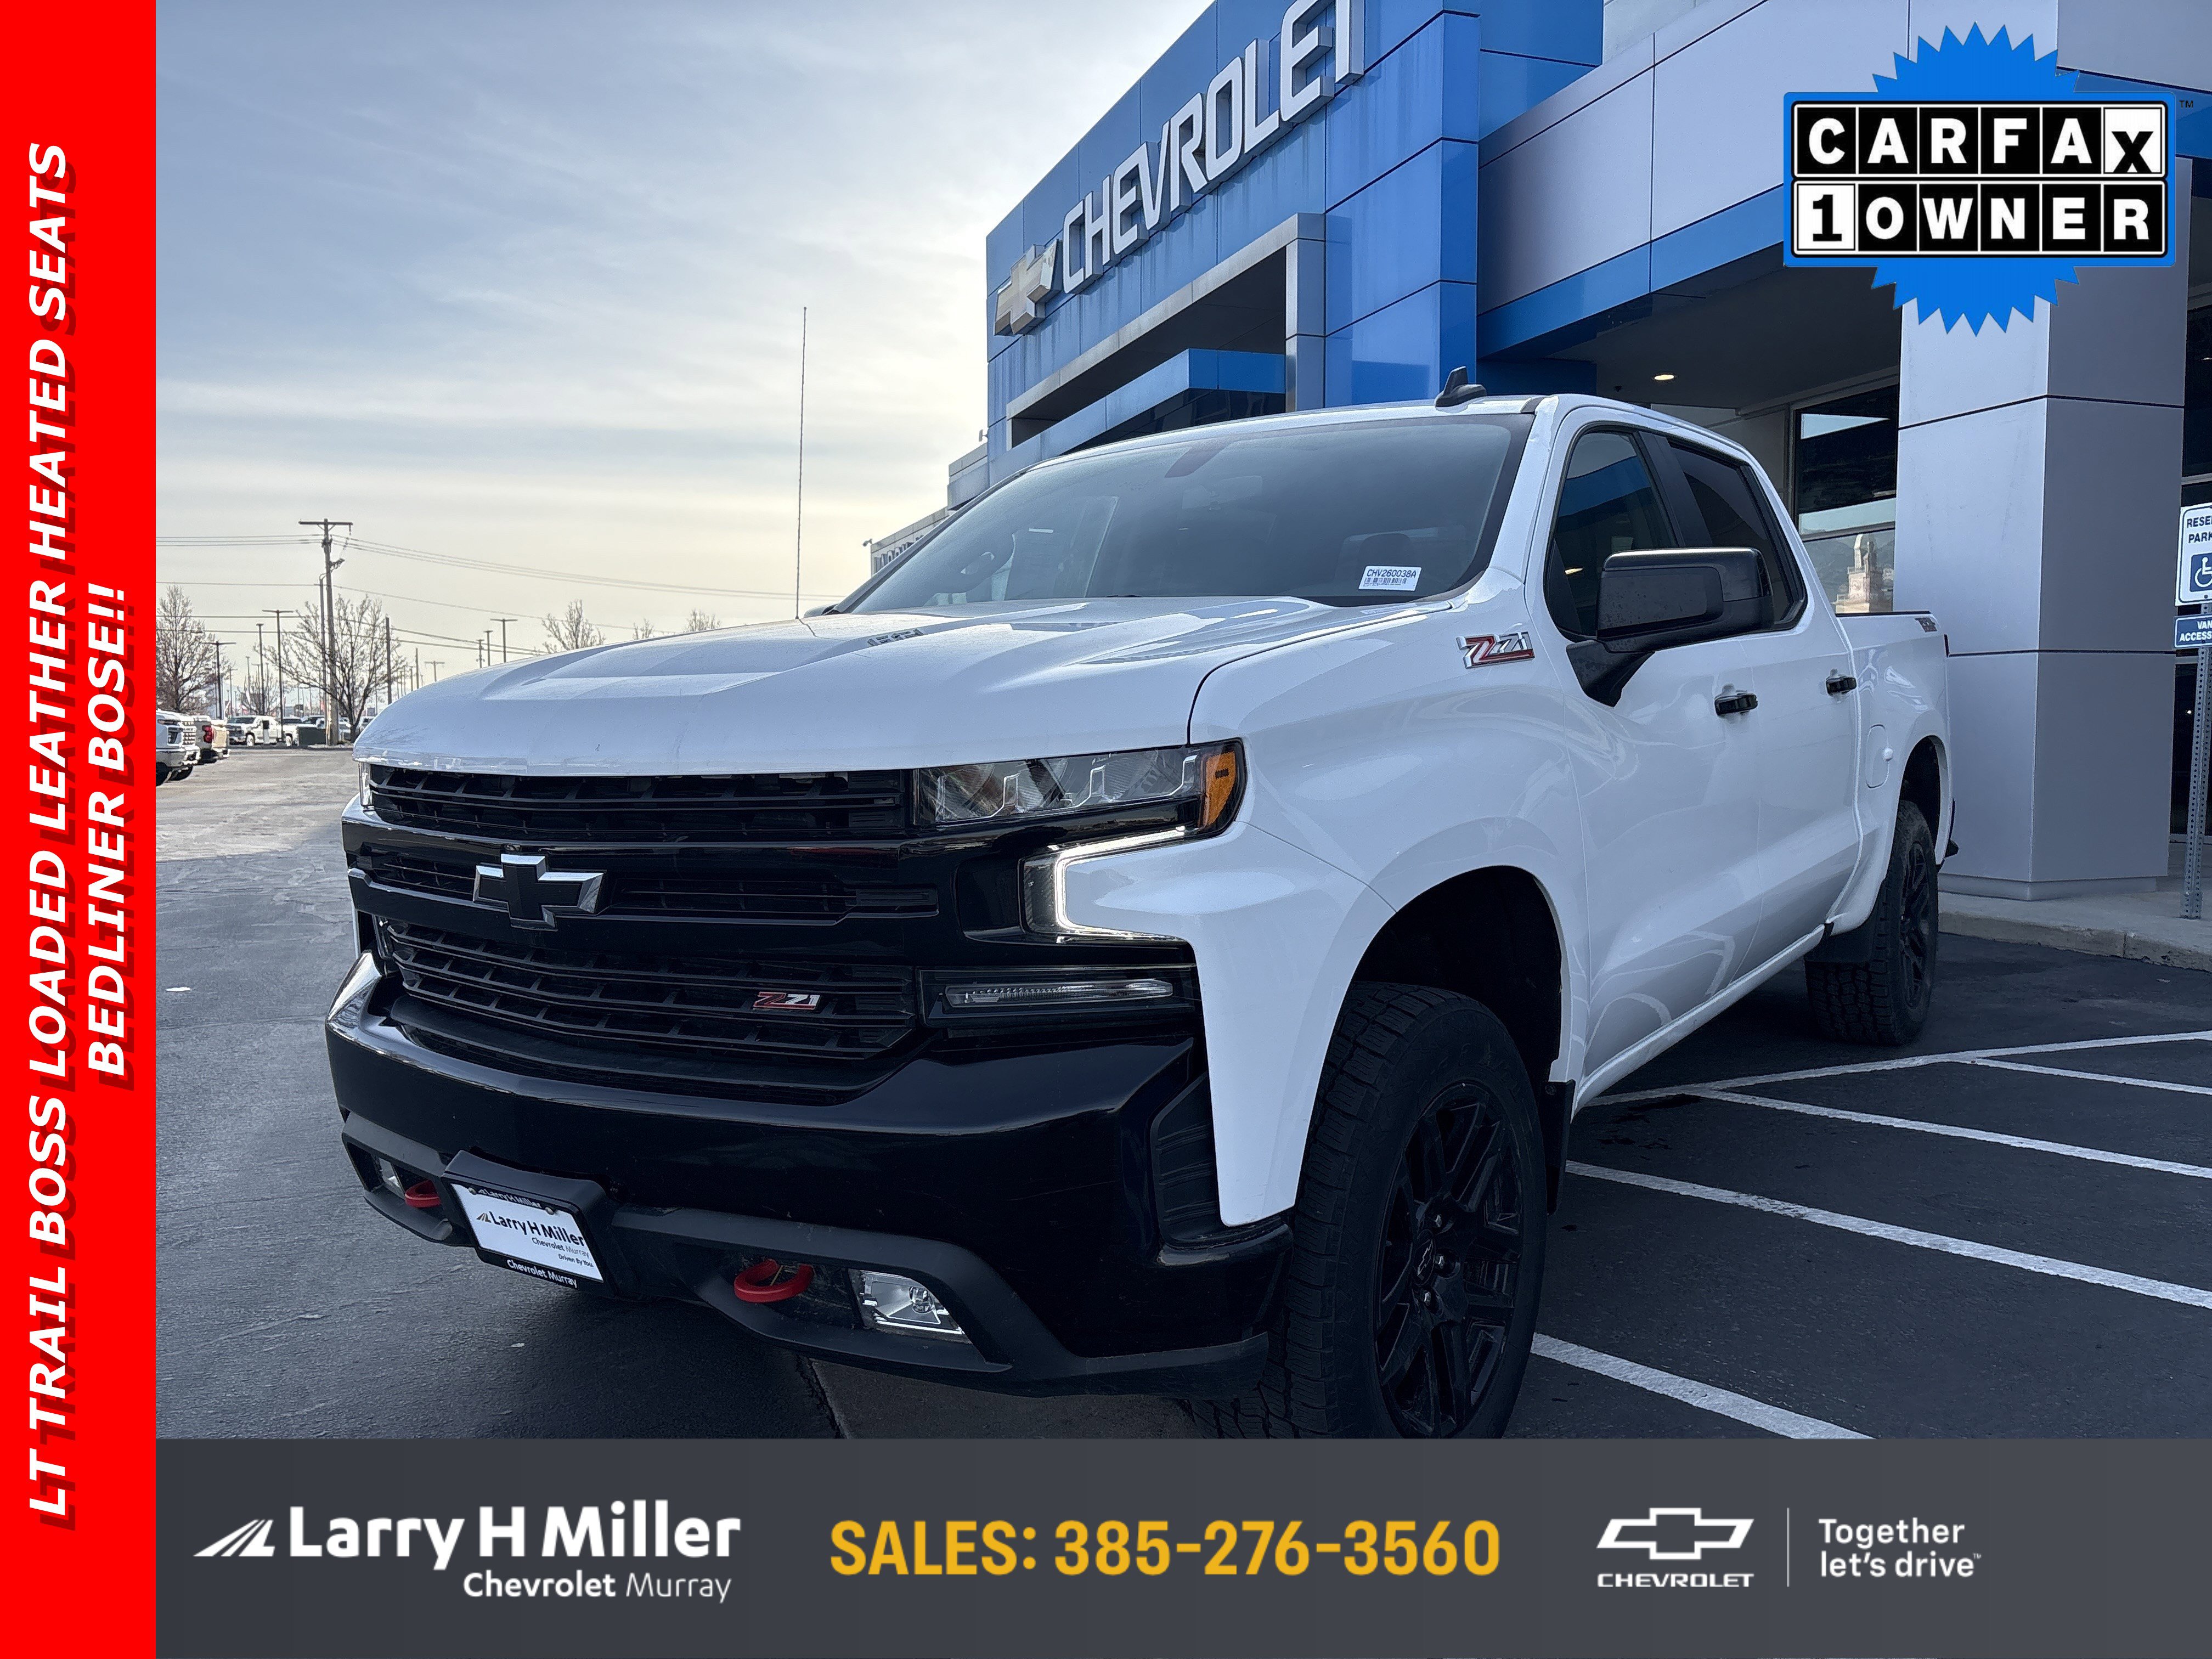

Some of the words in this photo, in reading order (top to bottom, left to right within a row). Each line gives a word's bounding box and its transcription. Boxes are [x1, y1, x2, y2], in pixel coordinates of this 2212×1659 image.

[2186, 515, 2212, 528] RESE
[1367, 569, 1417, 578] CHV260038A
[2197, 620, 2212, 630] VAN
[1455, 631, 1536, 669] Z71
[752, 991, 822, 1011] Z71
[489, 1211, 527, 1235] Larry
[527, 1220, 541, 1235] H
[540, 1223, 584, 1246] Miller
[532, 1237, 565, 1251] Chevrolet
[565, 1245, 589, 1259] Murray
[558, 1253, 575, 1263] Driven
[575, 1257, 583, 1266] By
[506, 1259, 548, 1278] Chevrolet
[548, 1270, 577, 1288] Murray
